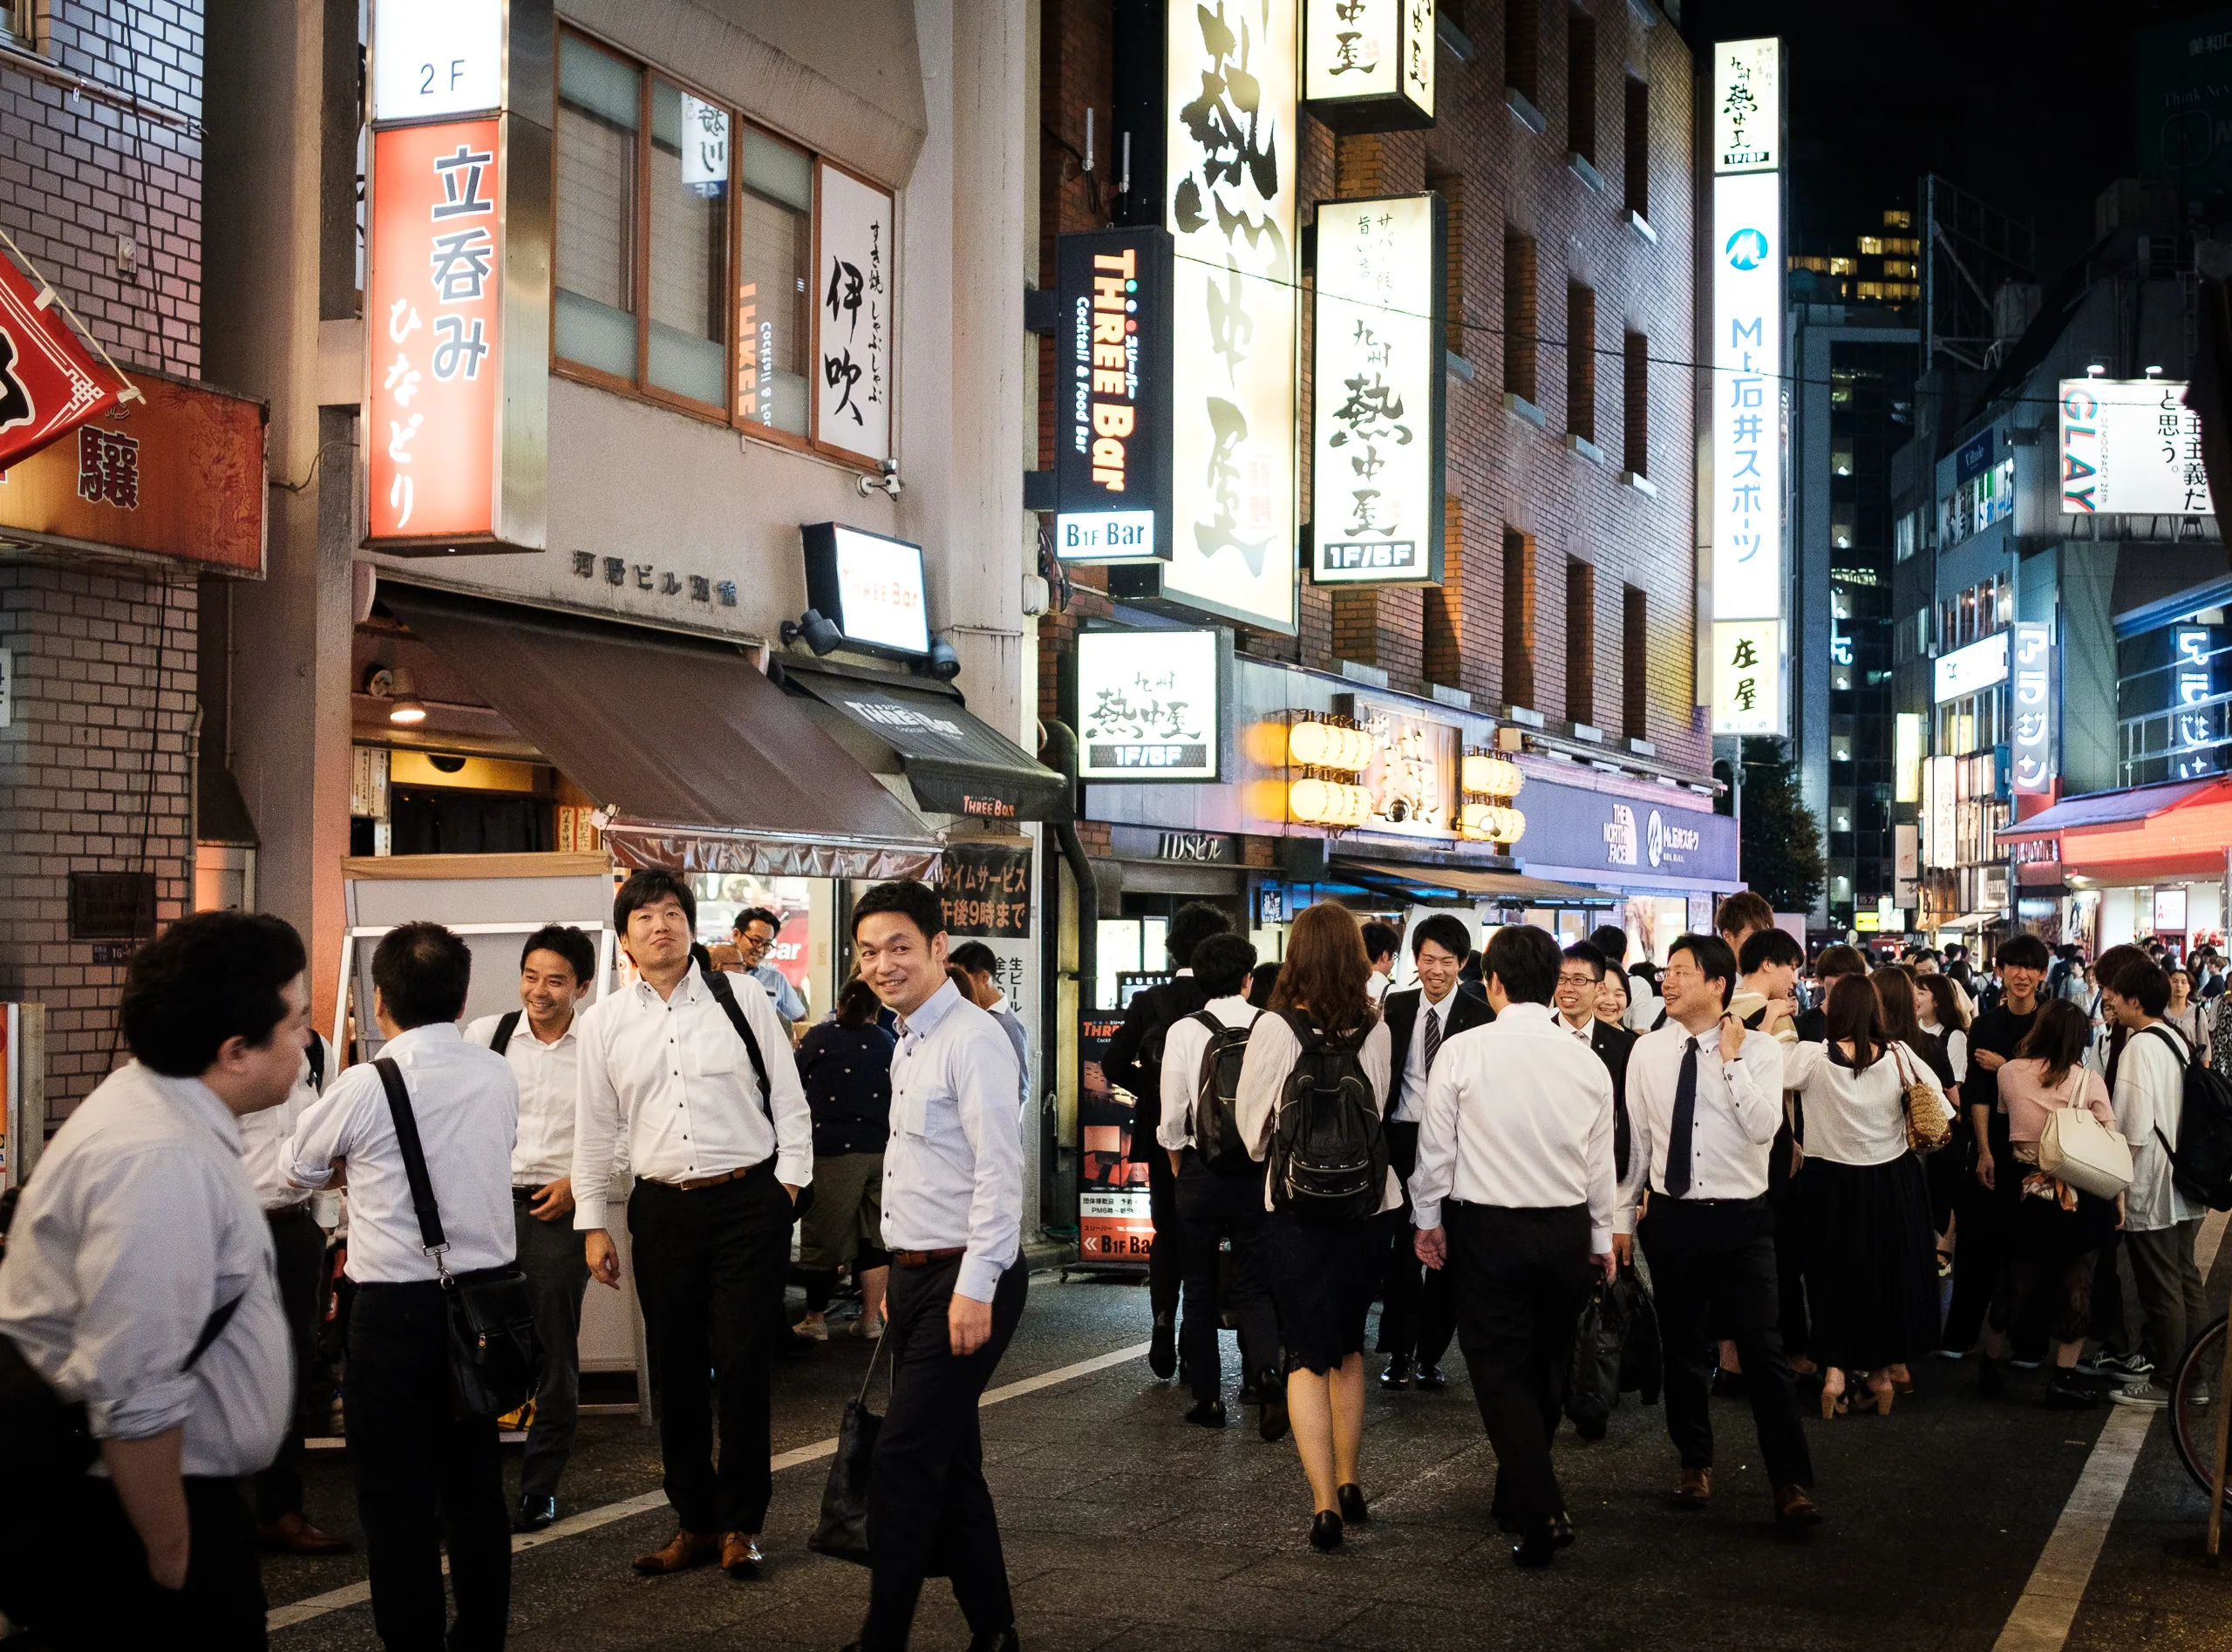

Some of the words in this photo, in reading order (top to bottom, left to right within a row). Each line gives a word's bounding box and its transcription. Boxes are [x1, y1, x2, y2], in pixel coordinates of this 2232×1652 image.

[432, 144, 493, 383] 立呑み
[825, 255, 864, 428] 伊吹
[1075, 296, 1090, 361] Cocktail
[1093, 248, 1135, 395] THREE
[868, 300, 882, 406] しゃぶしゃぶ
[1076, 364, 1089, 378] &
[384, 298, 425, 530] ひなどり
[1075, 382, 1089, 429] Food
[1076, 432, 1089, 454] Bar
[1092, 402, 1134, 493] Bar
[1329, 372, 1413, 538] 熱中屋
[2063, 386, 2098, 513] GLAY
[2183, 404, 2208, 511] 主主義だ
[1106, 520, 1145, 546] Bar
[892, 582, 918, 608] Bar
[1731, 637, 1759, 712] 庄屋
[1085, 687, 1201, 739] 熱中屋
[963, 795, 993, 814] THREE
[994, 799, 1016, 817] Bar
[1612, 803, 1627, 825] THE
[1161, 833, 1222, 862] IDSビル
[1603, 821, 1628, 845] NORTH
[1607, 842, 1628, 865] FACE
[941, 863, 1027, 894] タイムサービス
[940, 898, 1027, 929] 午後9時まで
[1009, 956, 1024, 1014] 生ビール
[1125, 976, 1172, 985] SUKIY
[1129, 1235, 1151, 1254] Ba
